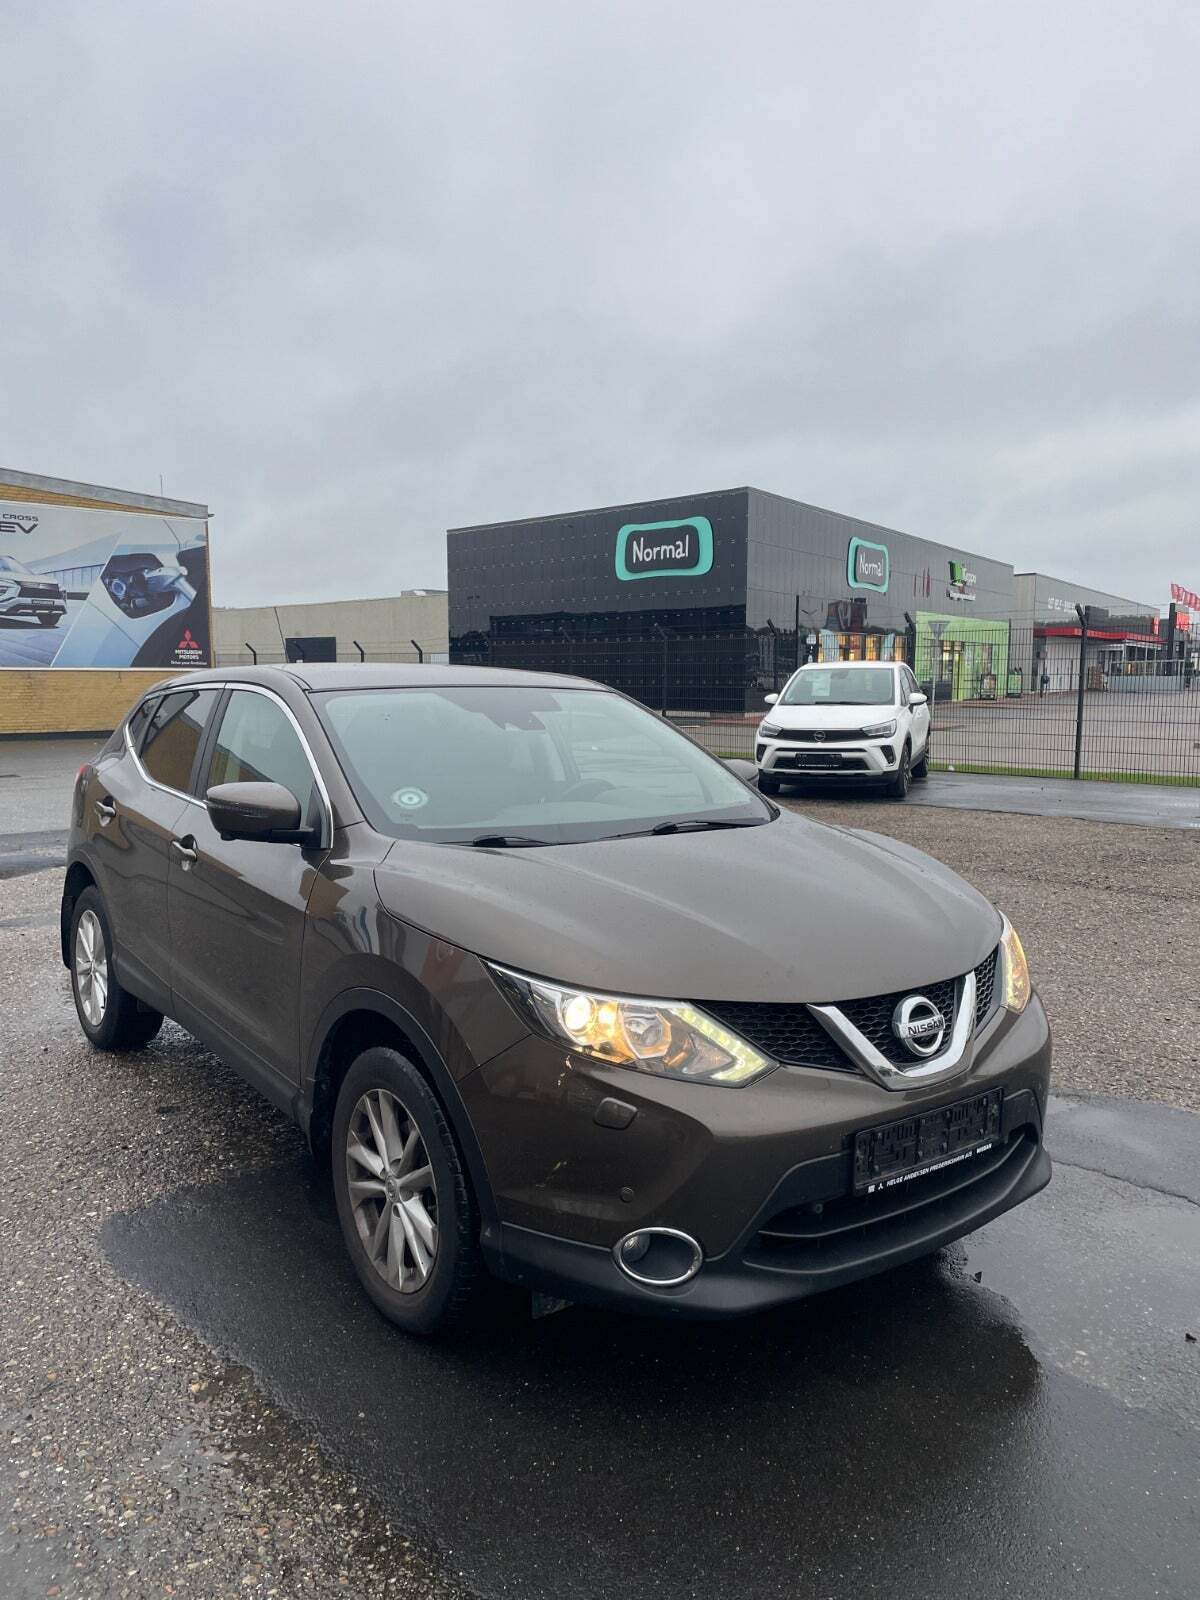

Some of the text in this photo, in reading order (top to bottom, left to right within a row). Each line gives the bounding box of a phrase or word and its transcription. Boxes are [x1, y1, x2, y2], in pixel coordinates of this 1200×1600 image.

[2, 513, 39, 522] CROSS
[632, 534, 689, 564] Normal
[859, 551, 884, 577] Normal
[907, 1019, 944, 1036] NISSAN
